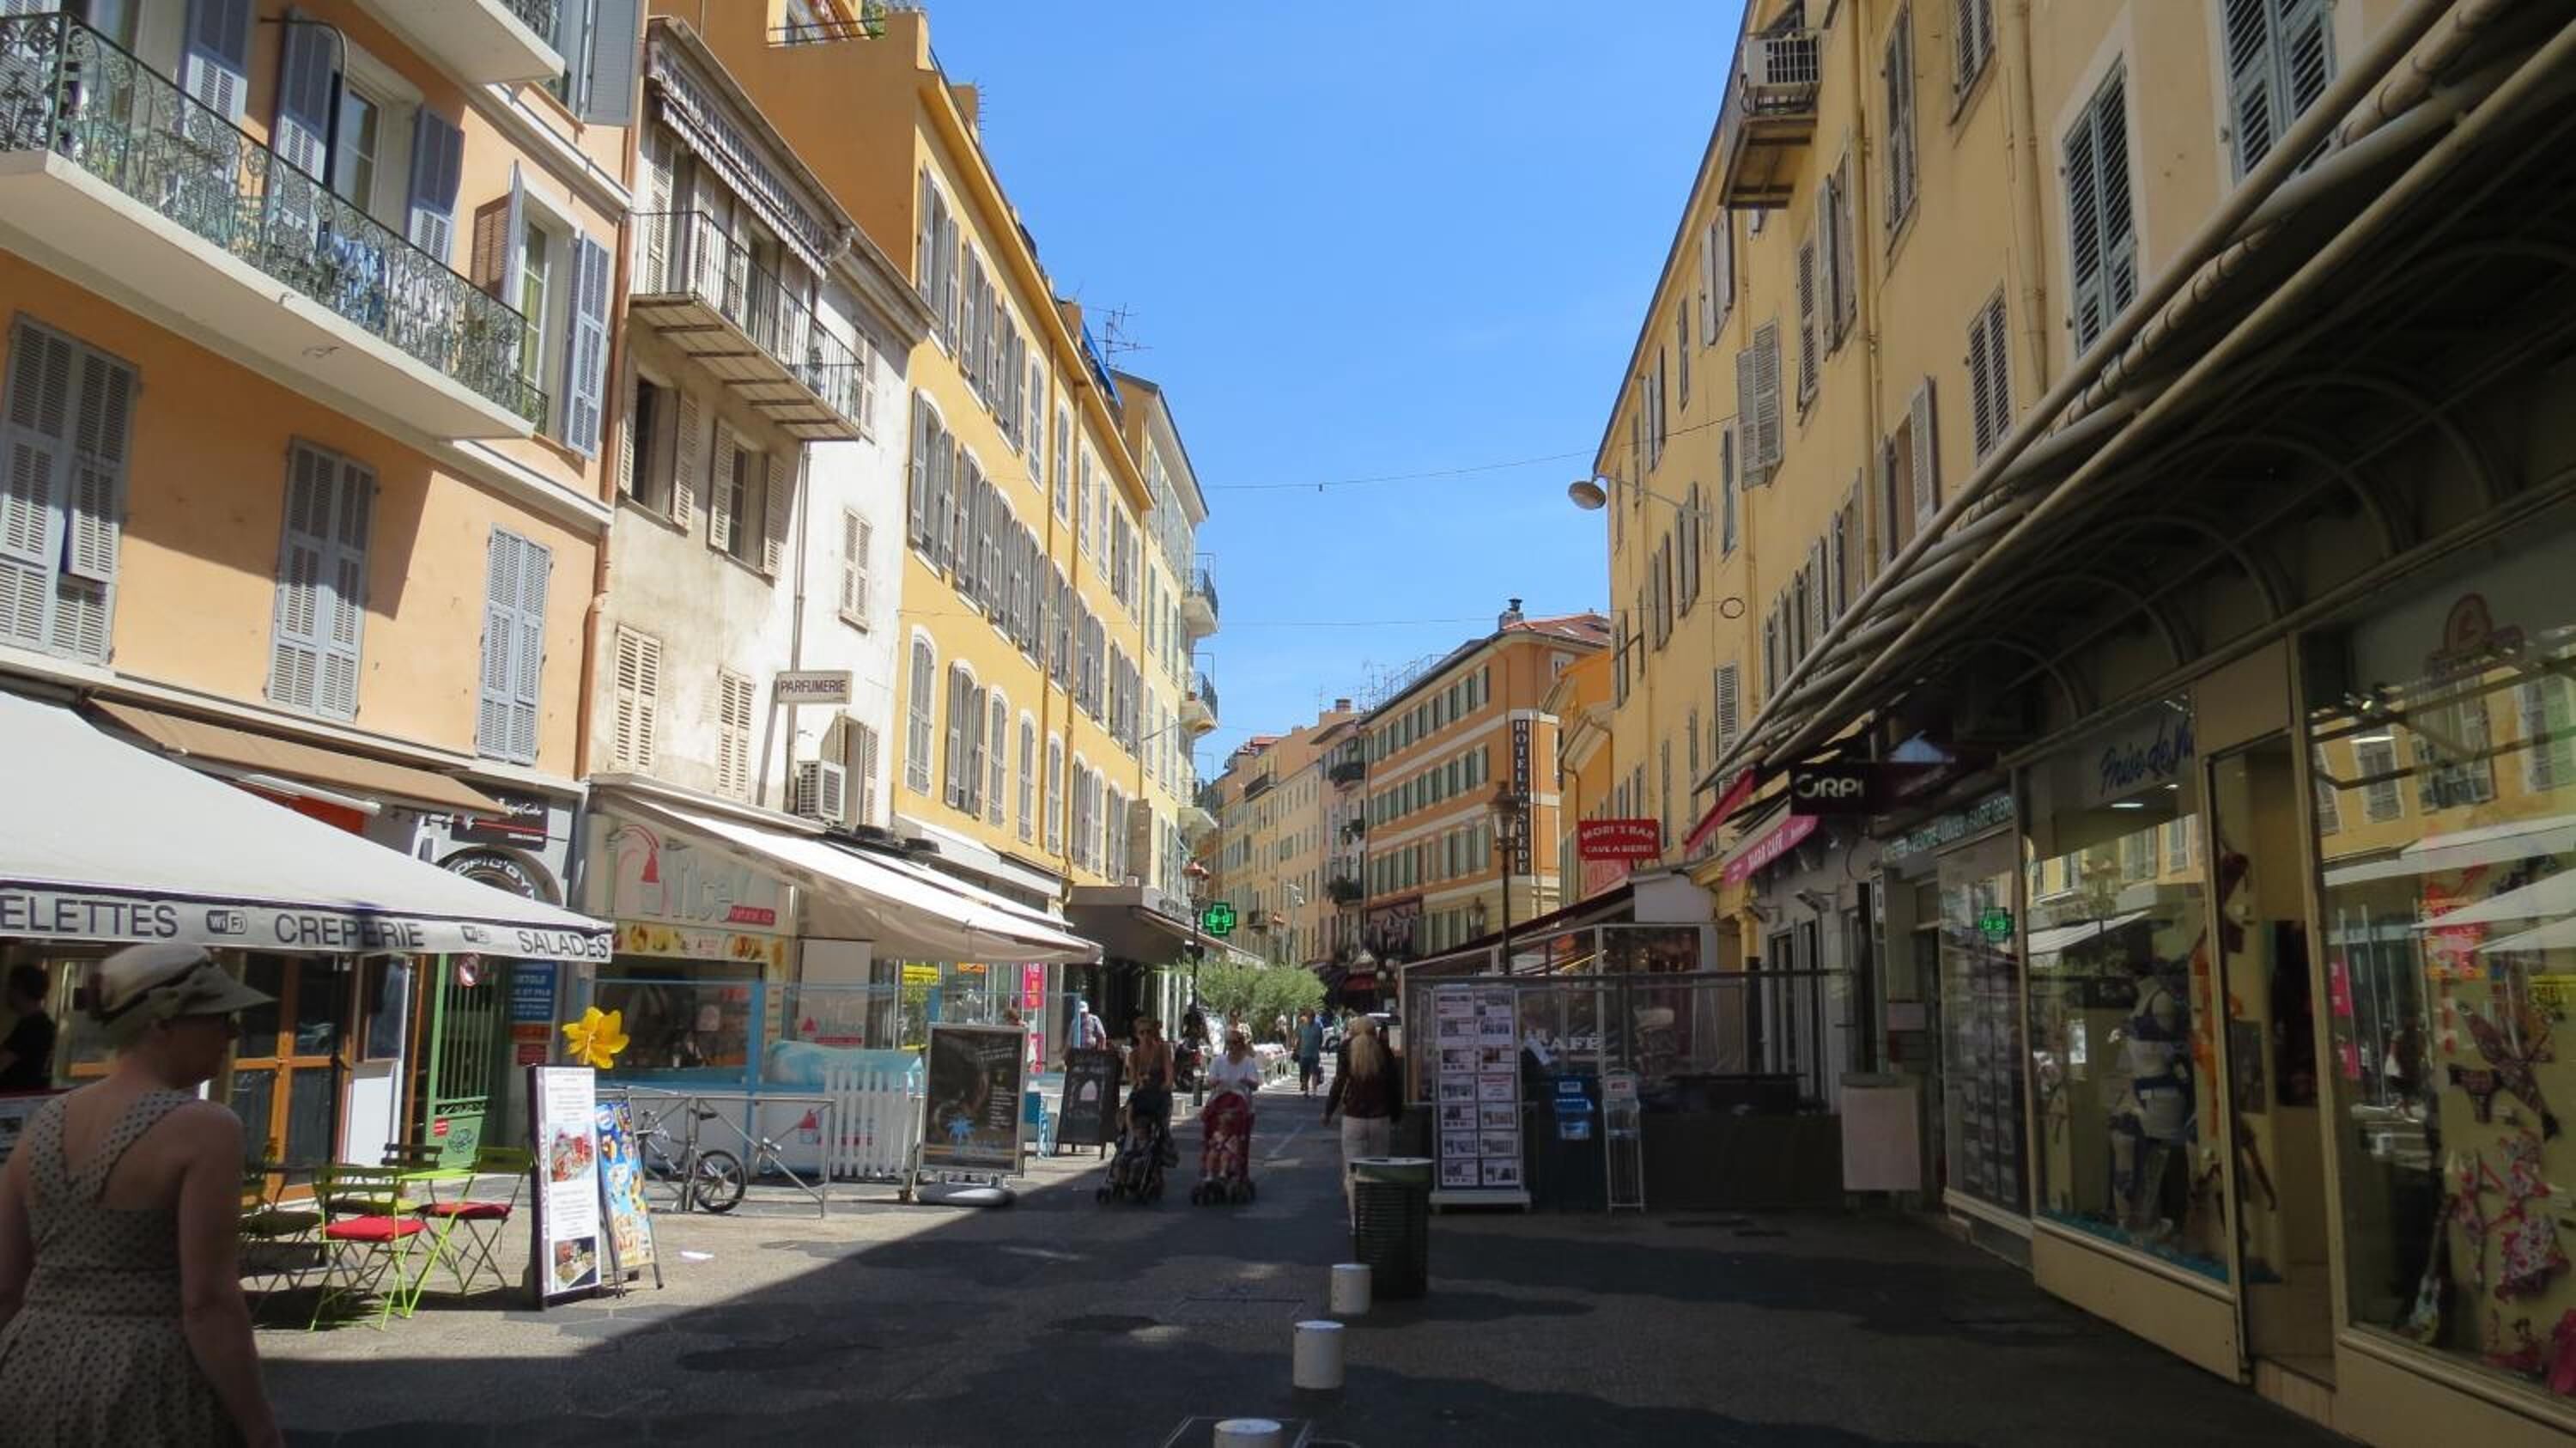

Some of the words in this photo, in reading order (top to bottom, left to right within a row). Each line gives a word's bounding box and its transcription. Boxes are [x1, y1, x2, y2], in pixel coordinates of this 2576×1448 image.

[781, 679, 847, 694] PARFUMERIE
[1795, 775, 1865, 799] ORPI
[0, 895, 179, 938] ELETTES
[275, 914, 425, 947] CREPERIE
[517, 930, 609, 958] SALADES
